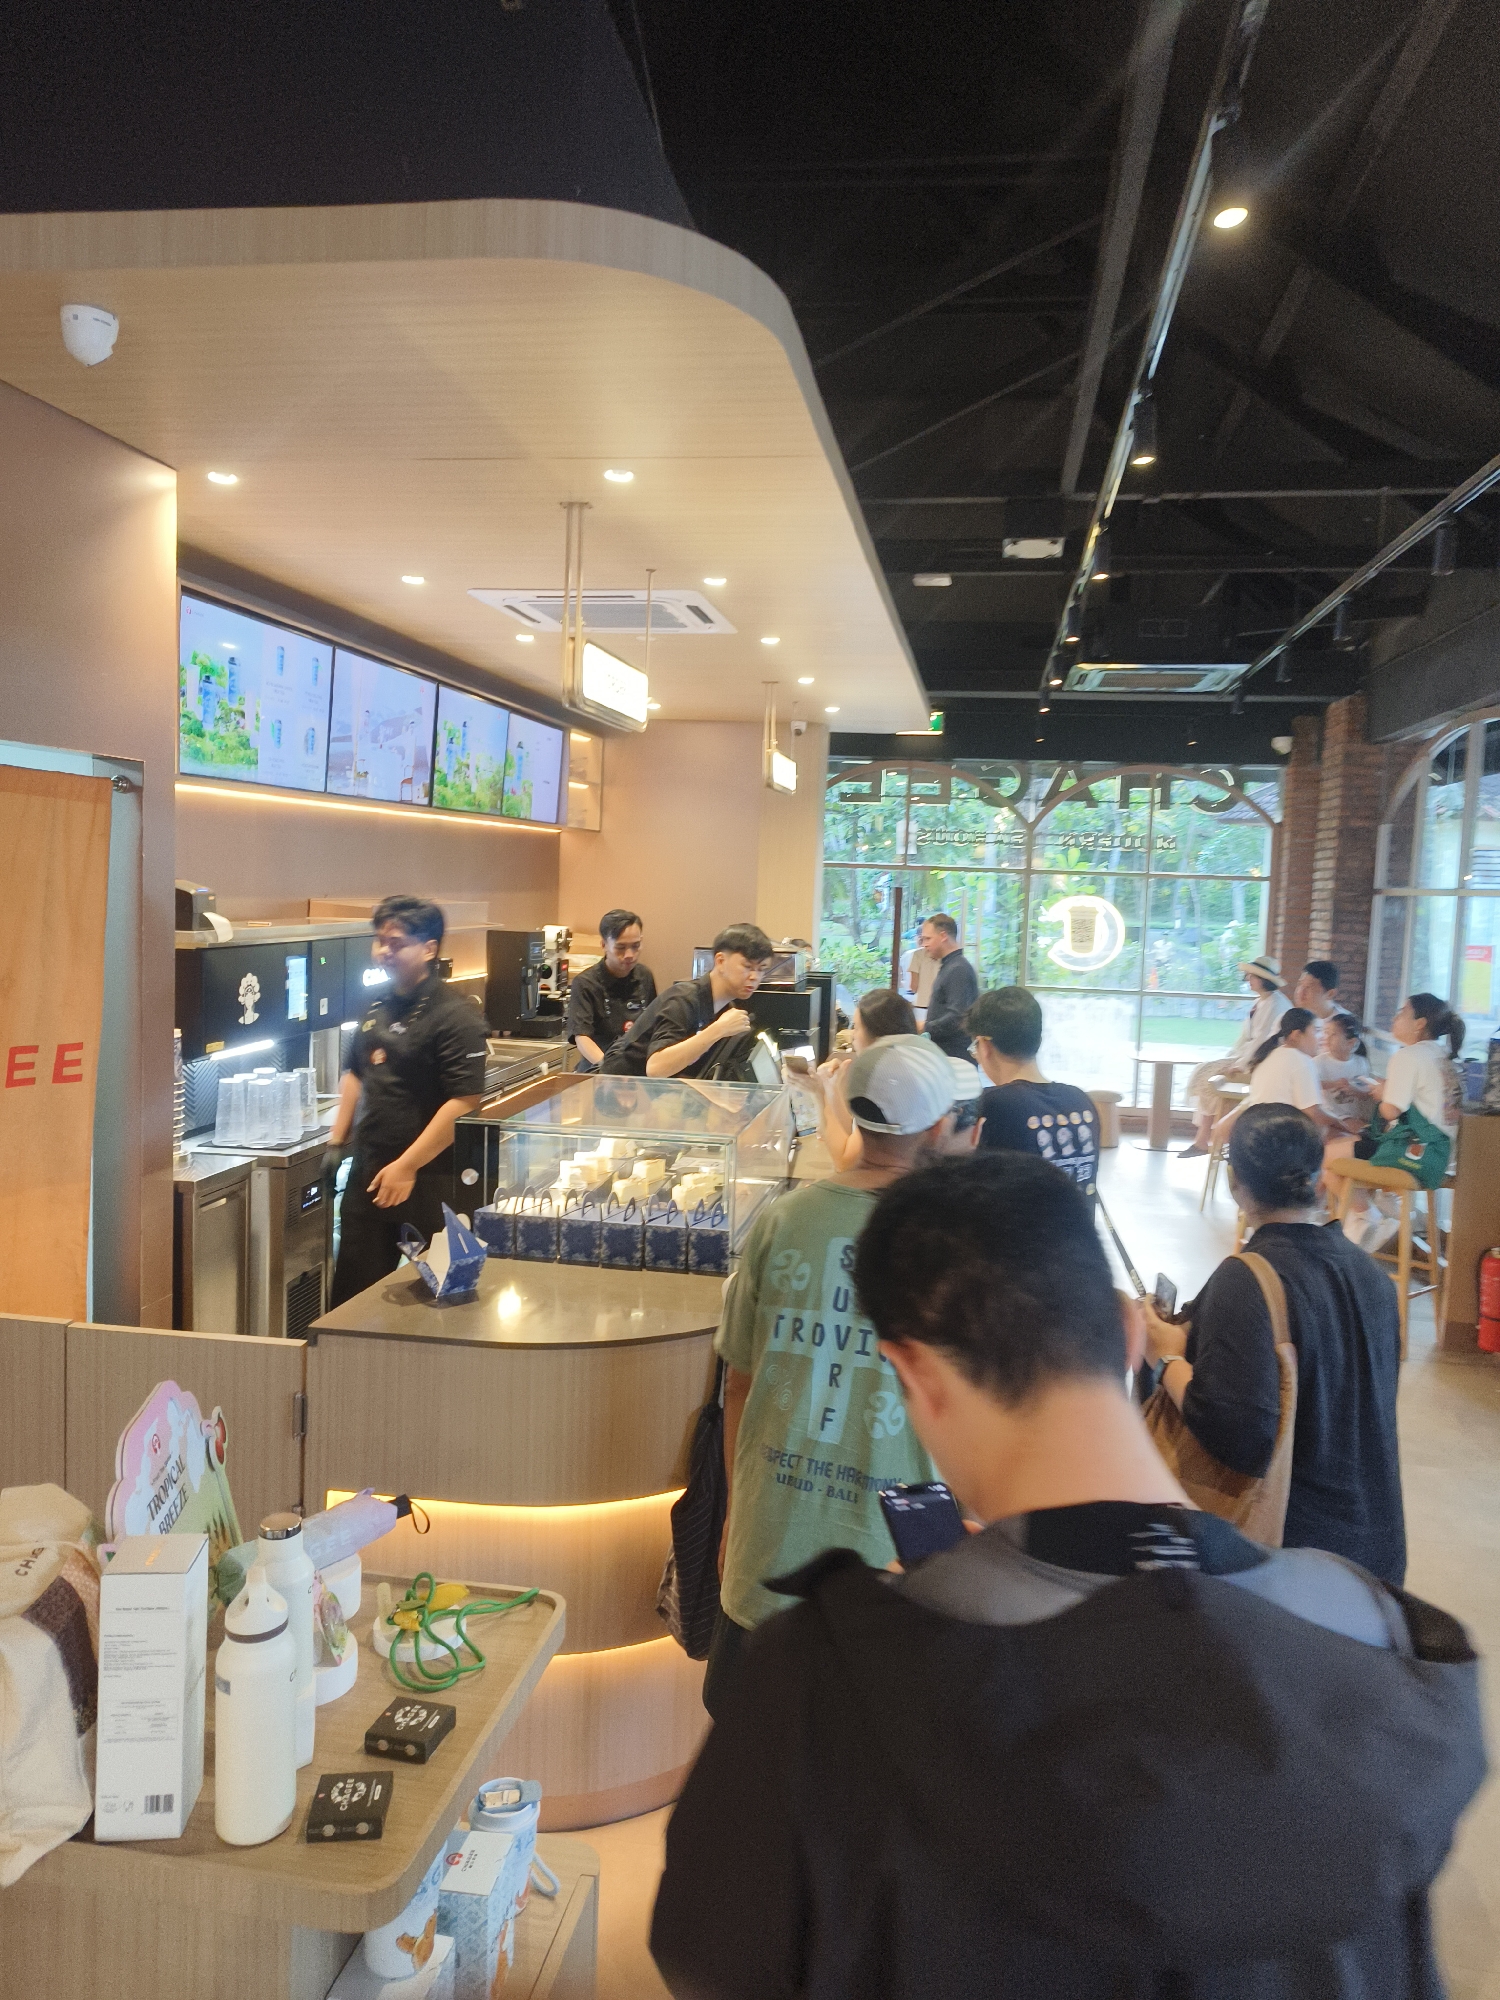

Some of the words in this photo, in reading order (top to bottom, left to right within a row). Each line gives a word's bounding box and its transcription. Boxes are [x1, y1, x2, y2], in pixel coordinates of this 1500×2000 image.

[146, 1454, 186, 1521] TROPICAL
[806, 1457, 834, 1479] THE
[158, 1483, 190, 1535] BREEZE
